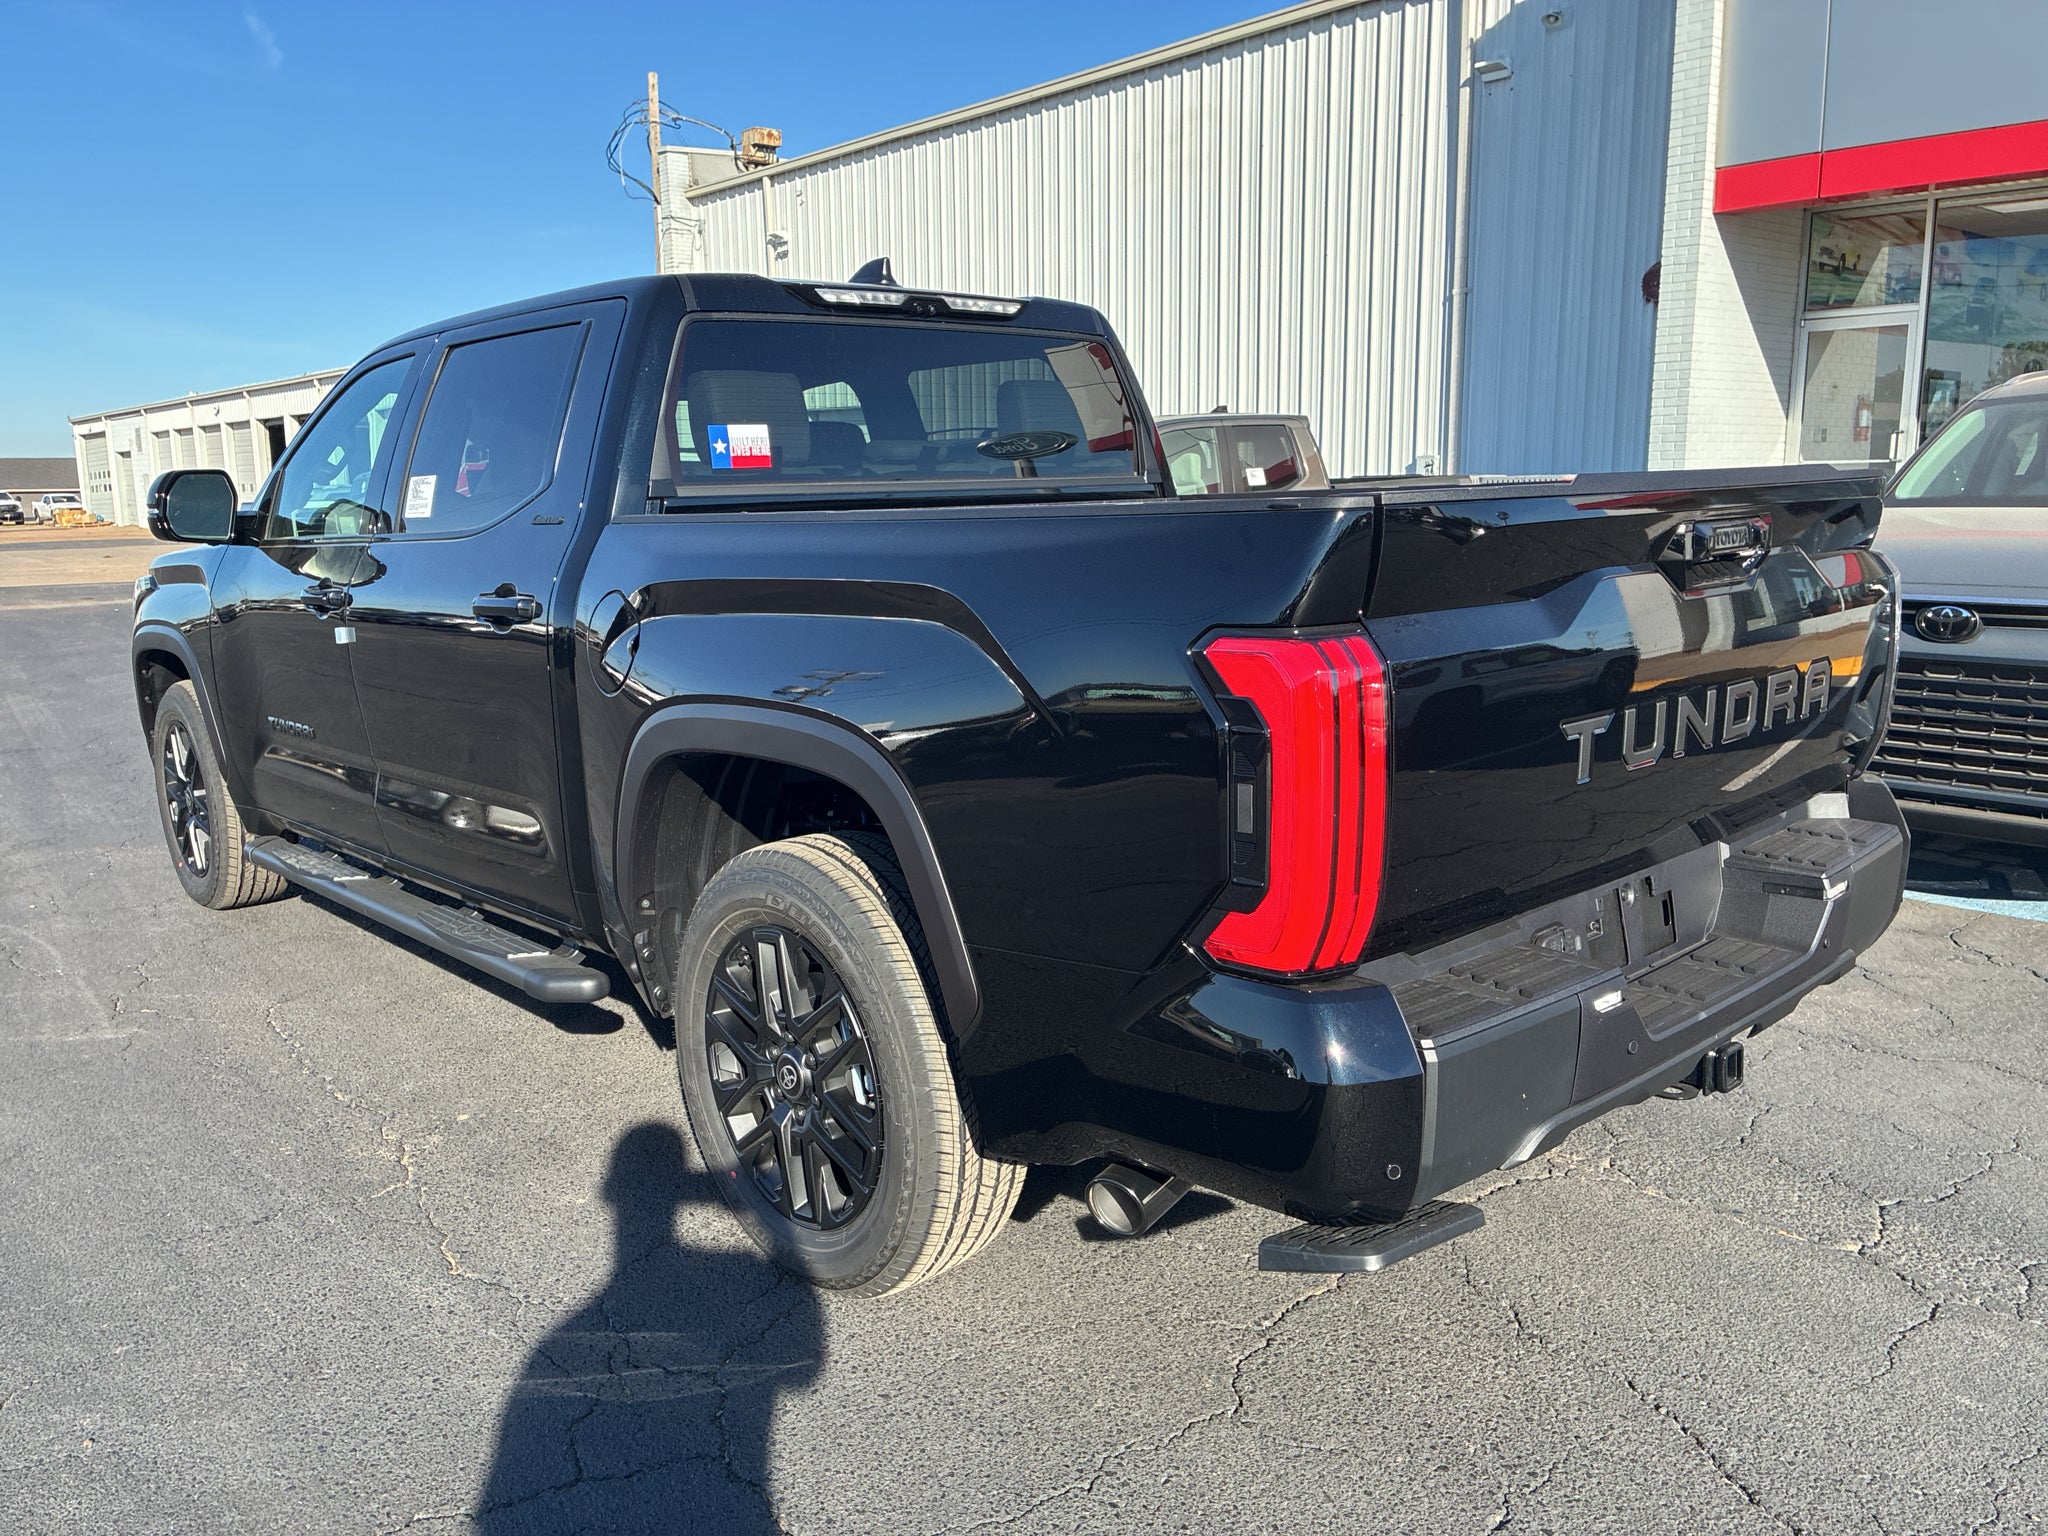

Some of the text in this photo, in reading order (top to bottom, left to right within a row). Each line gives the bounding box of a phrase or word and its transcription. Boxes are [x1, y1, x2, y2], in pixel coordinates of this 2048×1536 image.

[731, 446, 771, 456] LIVES HERE
[750, 436, 769, 446] HERE
[1715, 528, 1748, 548] TOYOTA
[267, 716, 316, 740] TUNDRA
[1559, 656, 1833, 785] TUNDRA
